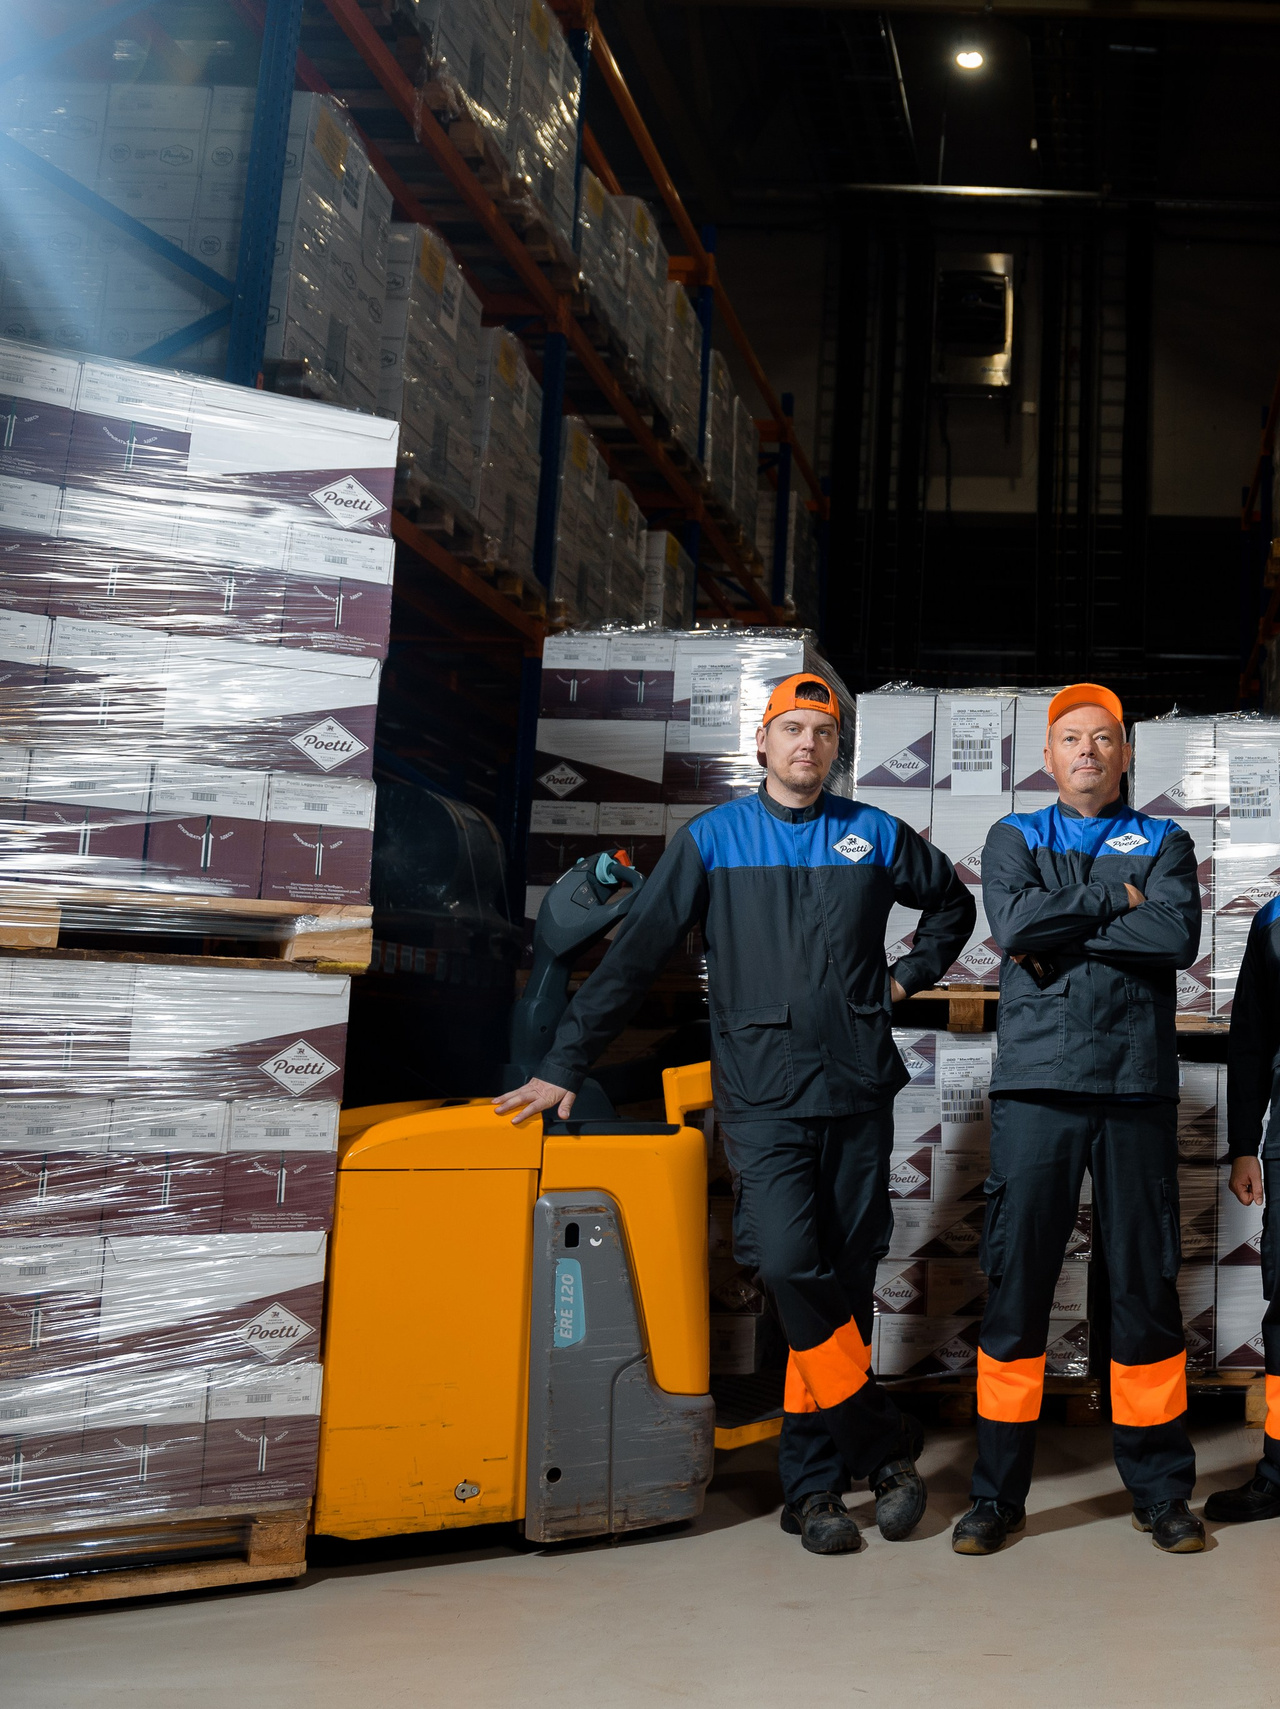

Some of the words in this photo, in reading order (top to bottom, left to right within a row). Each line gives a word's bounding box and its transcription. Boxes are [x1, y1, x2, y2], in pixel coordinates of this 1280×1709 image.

[102, 427, 128, 445] ОТКРЫВАТЬ
[143, 436, 158, 444] ЗДЕСЬ
[324, 491, 373, 511] Poetti
[303, 734, 354, 752] Poetti
[889, 759, 920, 770] Poetti
[545, 775, 578, 785] Poetti
[177, 824, 203, 841] ОТКРЫВАТЬ
[220, 831, 234, 841] ЗДЕСЬ
[293, 833, 316, 849] ОТКРЫВАТЬ
[330, 840, 343, 850] ЗДЕСЬ
[1112, 837, 1142, 847] Poetti
[839, 845, 868, 854] Poetti
[1250, 888, 1280, 898] Poetti
[964, 955, 996, 967] Poetti
[273, 1059, 325, 1075] Poetti
[293, 1164, 308, 1175] ЗДЕСЬ
[889, 1172, 920, 1184] Poetti
[944, 1231, 977, 1243] Poetti
[561, 1274, 574, 1304] 120
[881, 1287, 913, 1299] Poetti
[1052, 1302, 1082, 1313] Poetti
[560, 1308, 573, 1338] ERE
[248, 1324, 300, 1340] Poetti
[938, 1348, 971, 1359] Poetti
[234, 1428, 259, 1443] ОТКРЫВАТЬ
[274, 1430, 289, 1442] ЗДЕСЬ
